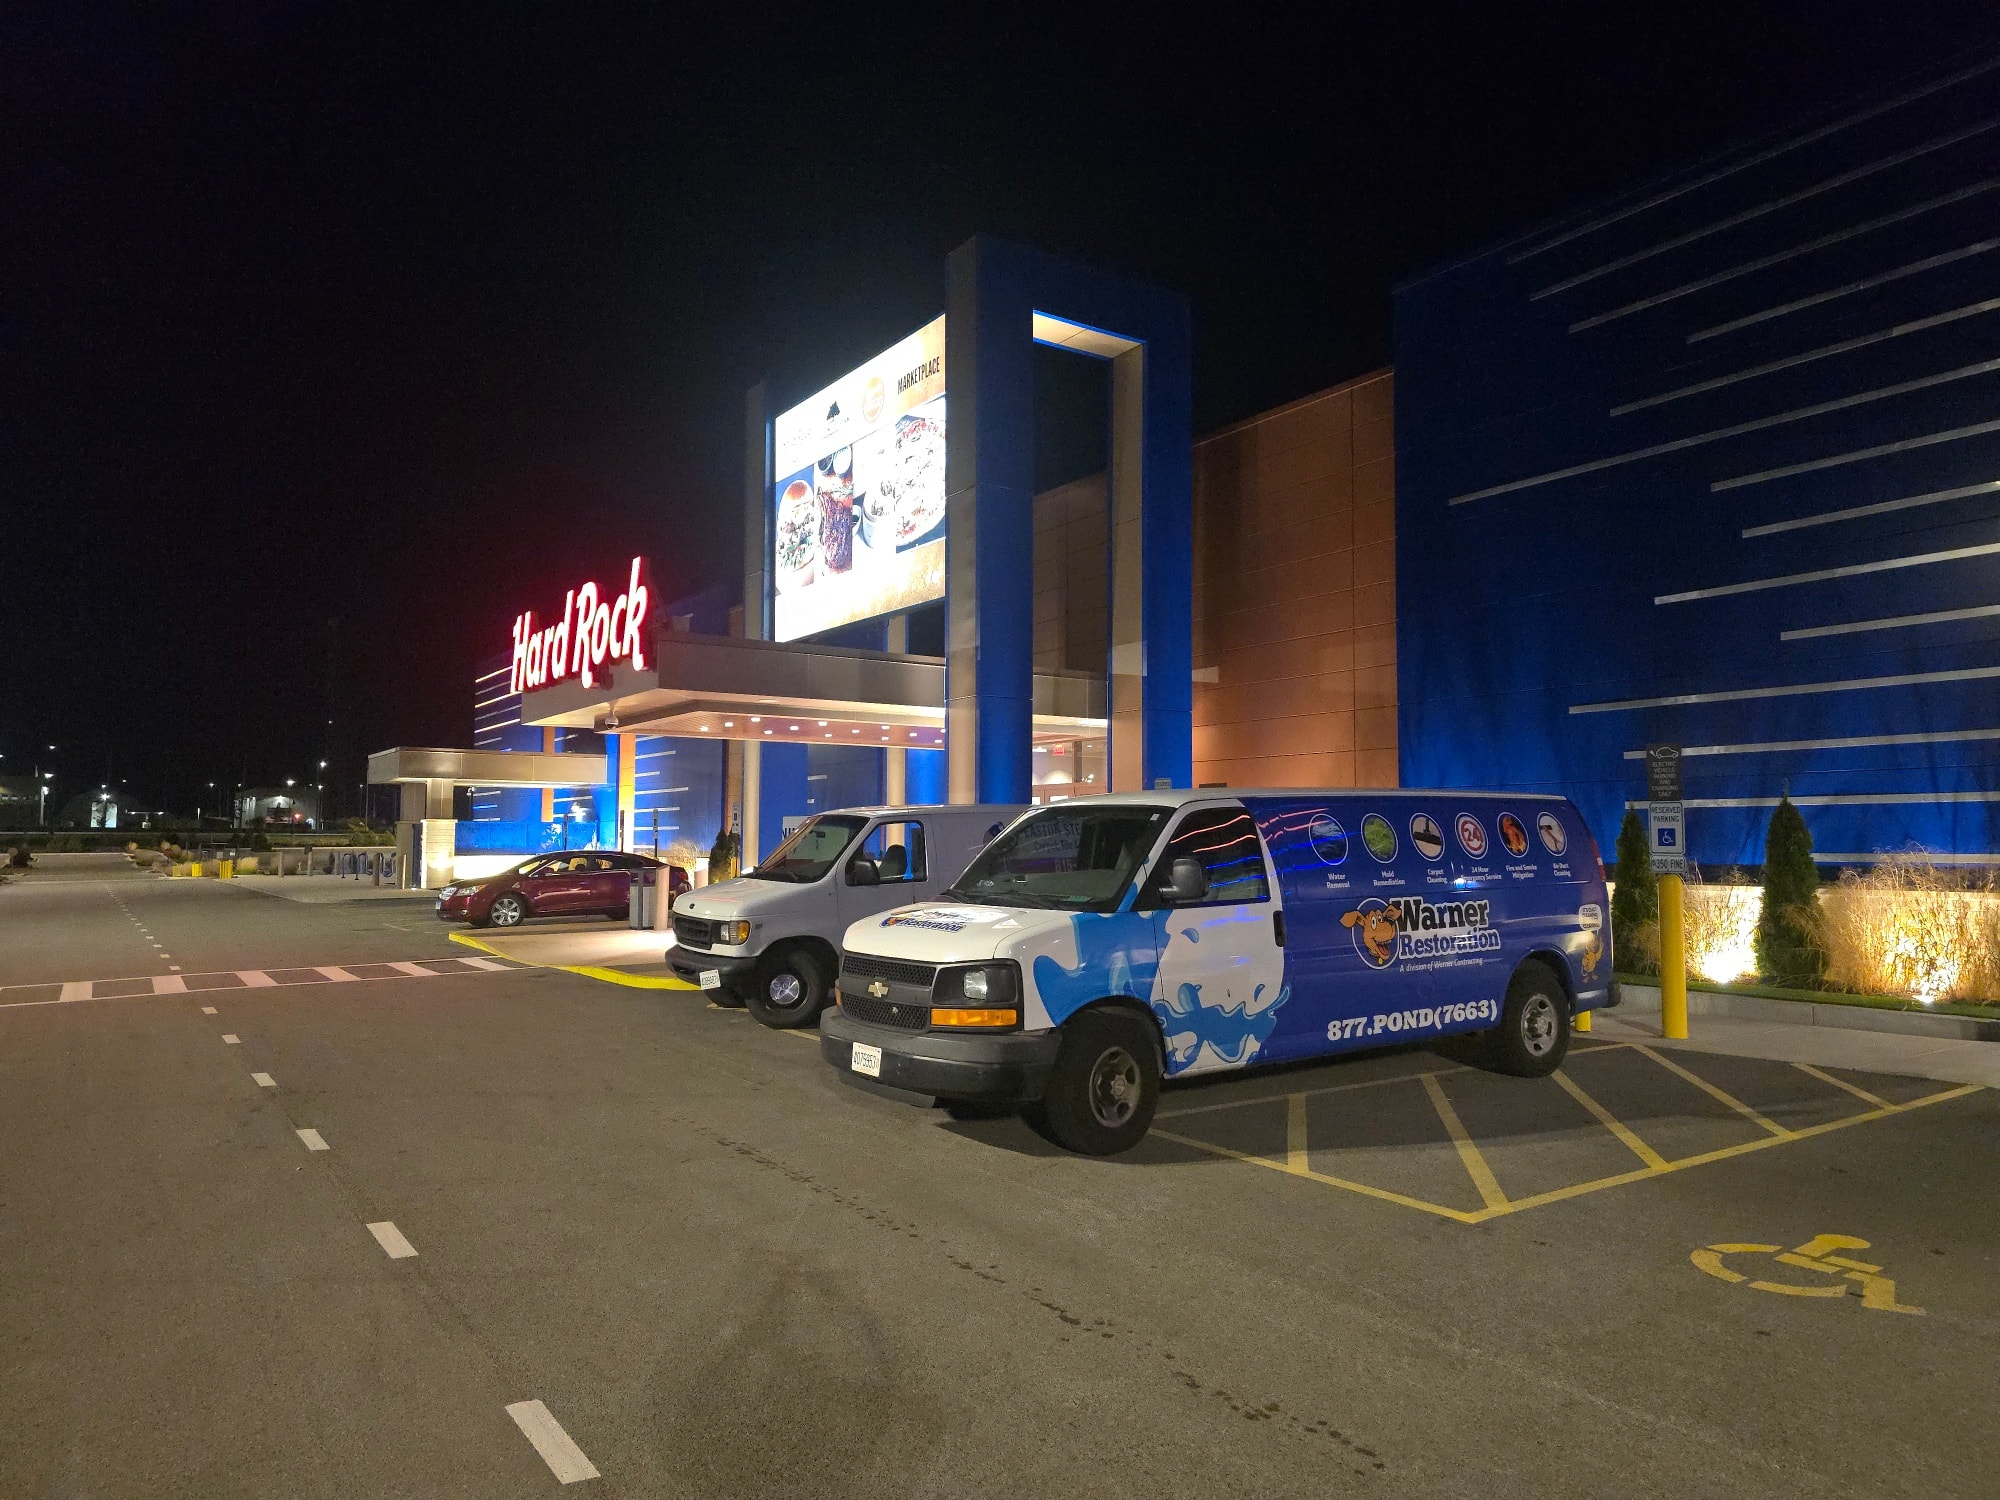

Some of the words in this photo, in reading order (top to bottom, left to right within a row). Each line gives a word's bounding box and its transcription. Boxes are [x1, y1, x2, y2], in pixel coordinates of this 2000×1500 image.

[897, 356, 940, 395] MARKETPLACE
[490, 589, 575, 692] Hard
[572, 556, 649, 689] Rock
[1652, 806, 1681, 814] RESERVED
[1653, 815, 1680, 823] PARKING
[1670, 859, 1684, 869] FINE
[1381, 870, 1395, 878] Mold
[1427, 868, 1444, 876] Carpet
[1427, 875, 1448, 884] Cleaning
[1390, 898, 1488, 932] Warner
[1400, 927, 1500, 958] Restoration
[1400, 964, 1405, 973] A
[1327, 998, 1498, 1041] 877.POND(7663)
